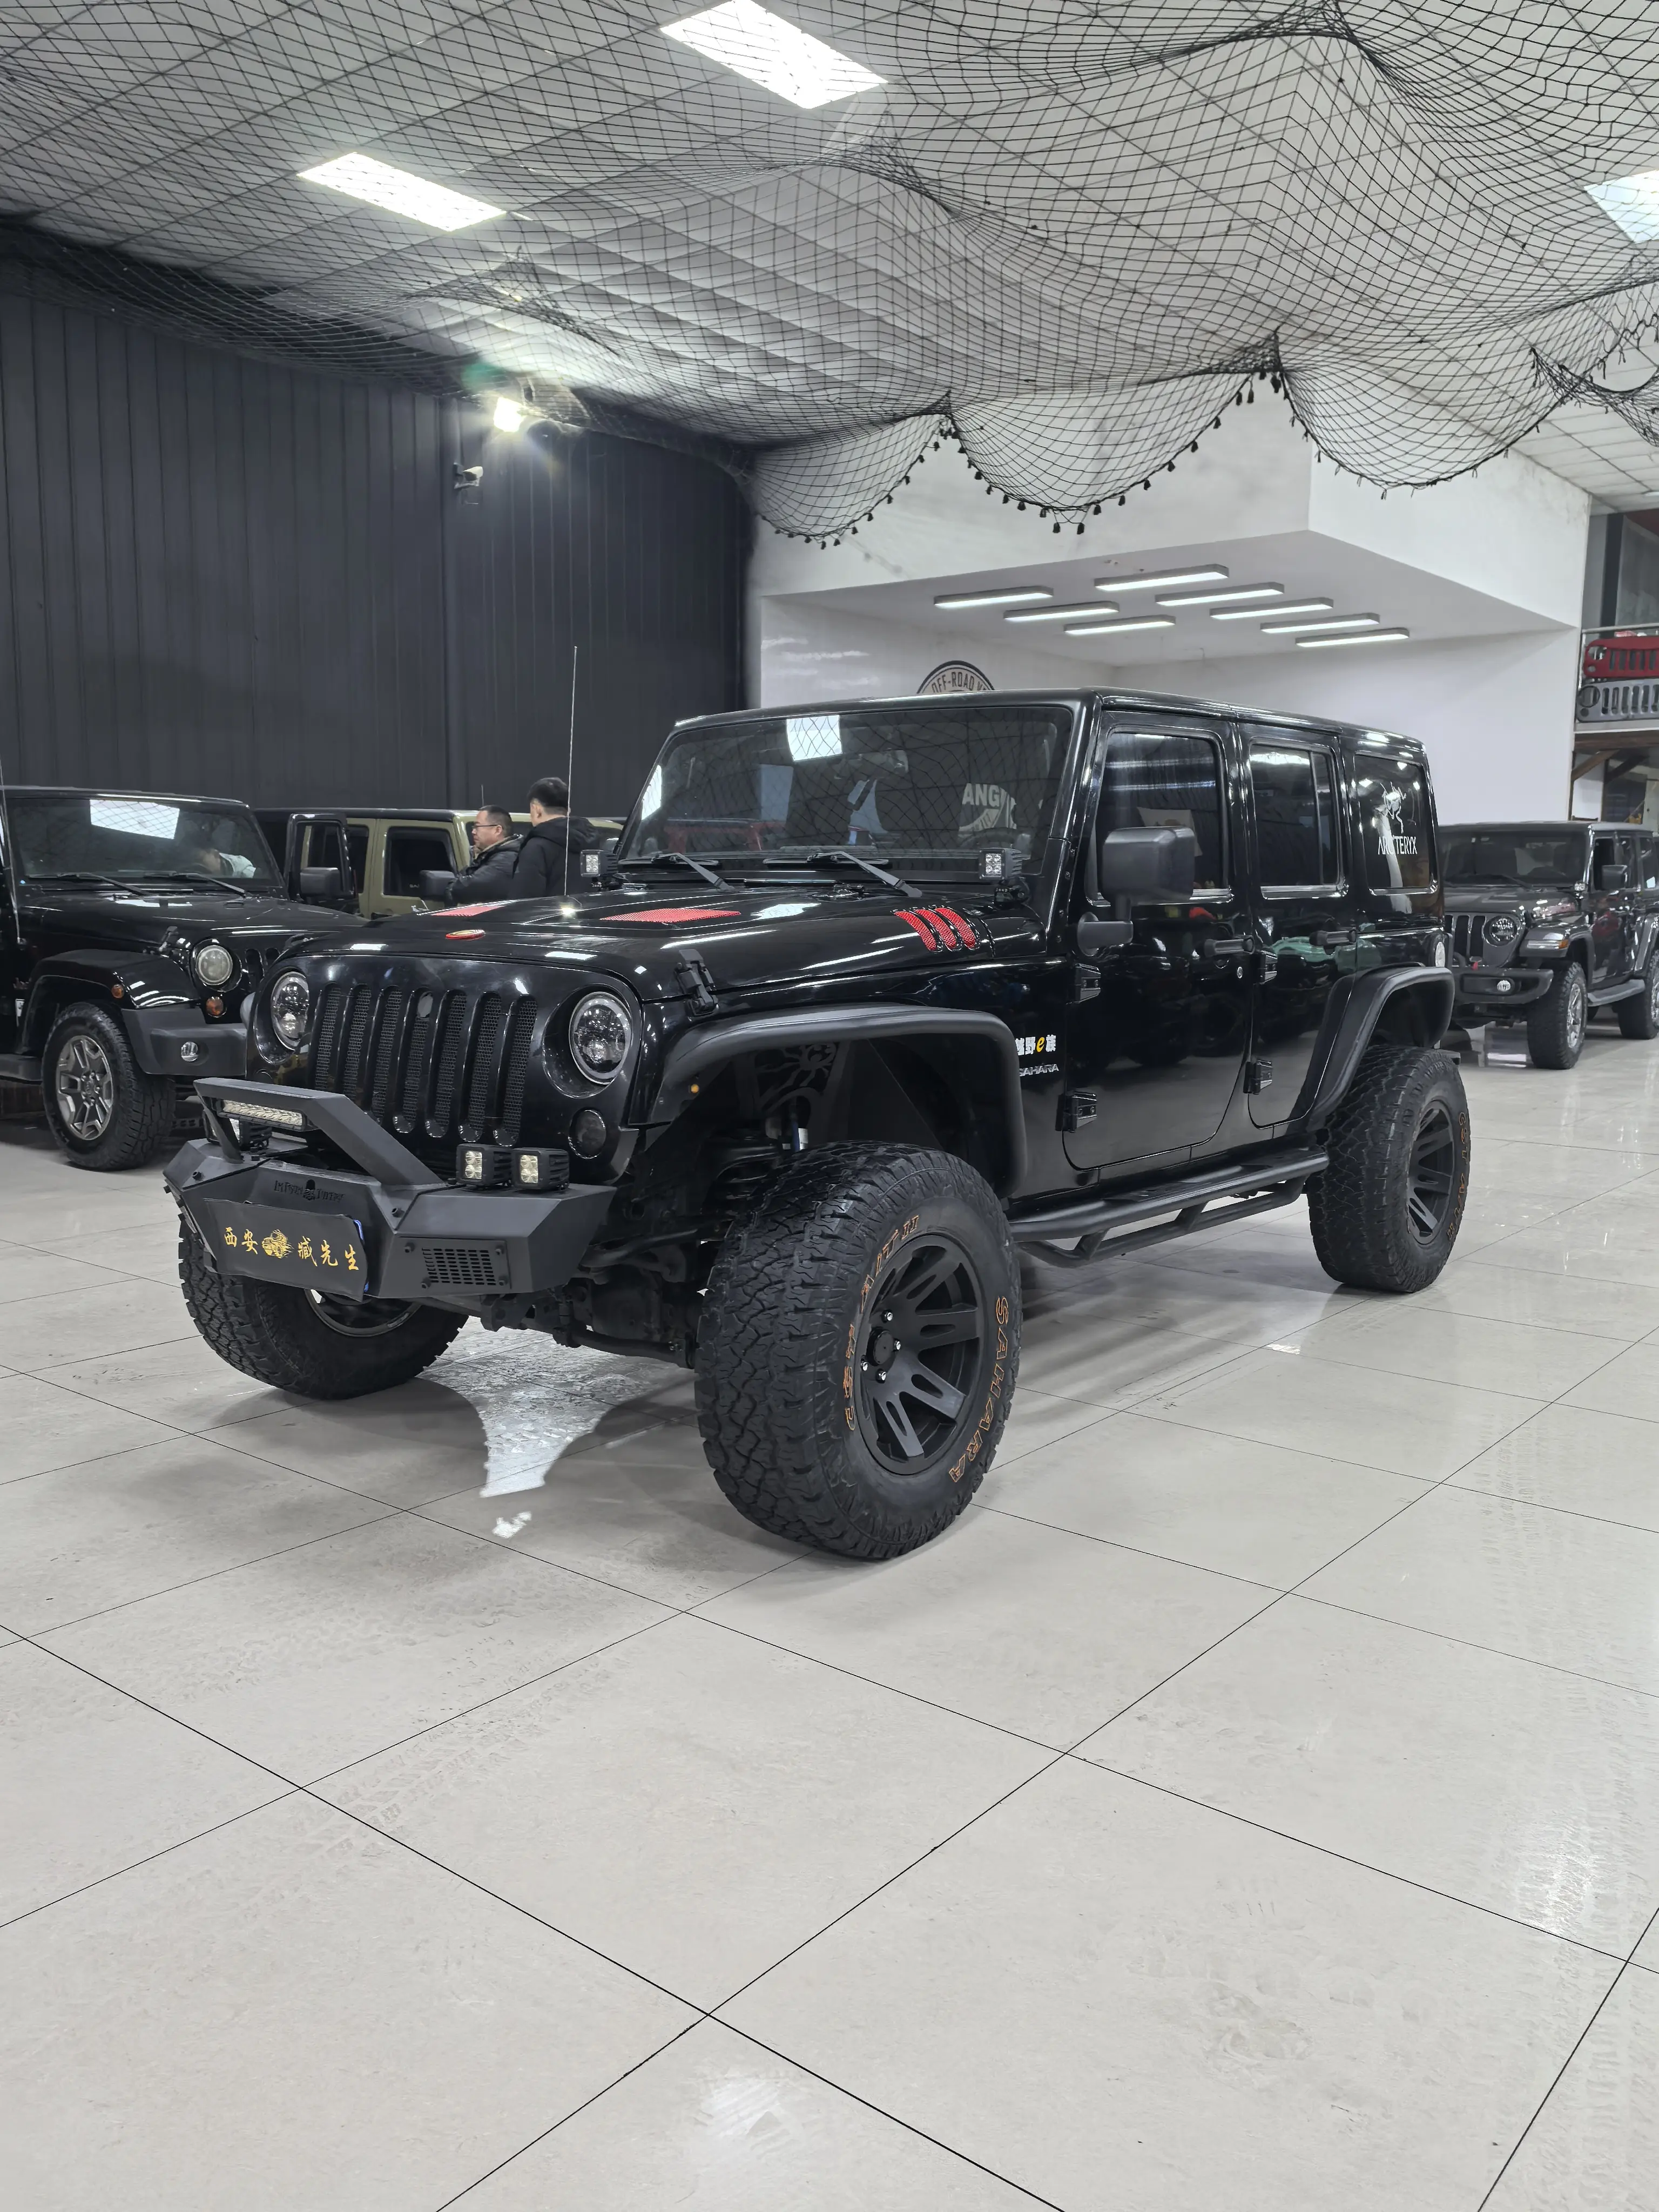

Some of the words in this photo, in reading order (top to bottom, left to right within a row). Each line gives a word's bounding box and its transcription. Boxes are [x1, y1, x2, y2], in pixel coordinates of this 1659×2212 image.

[931, 671, 975, 693] OFF-ROAD
[224, 1226, 258, 1255] 西安
[949, 1296, 1009, 1483] SAHARA
